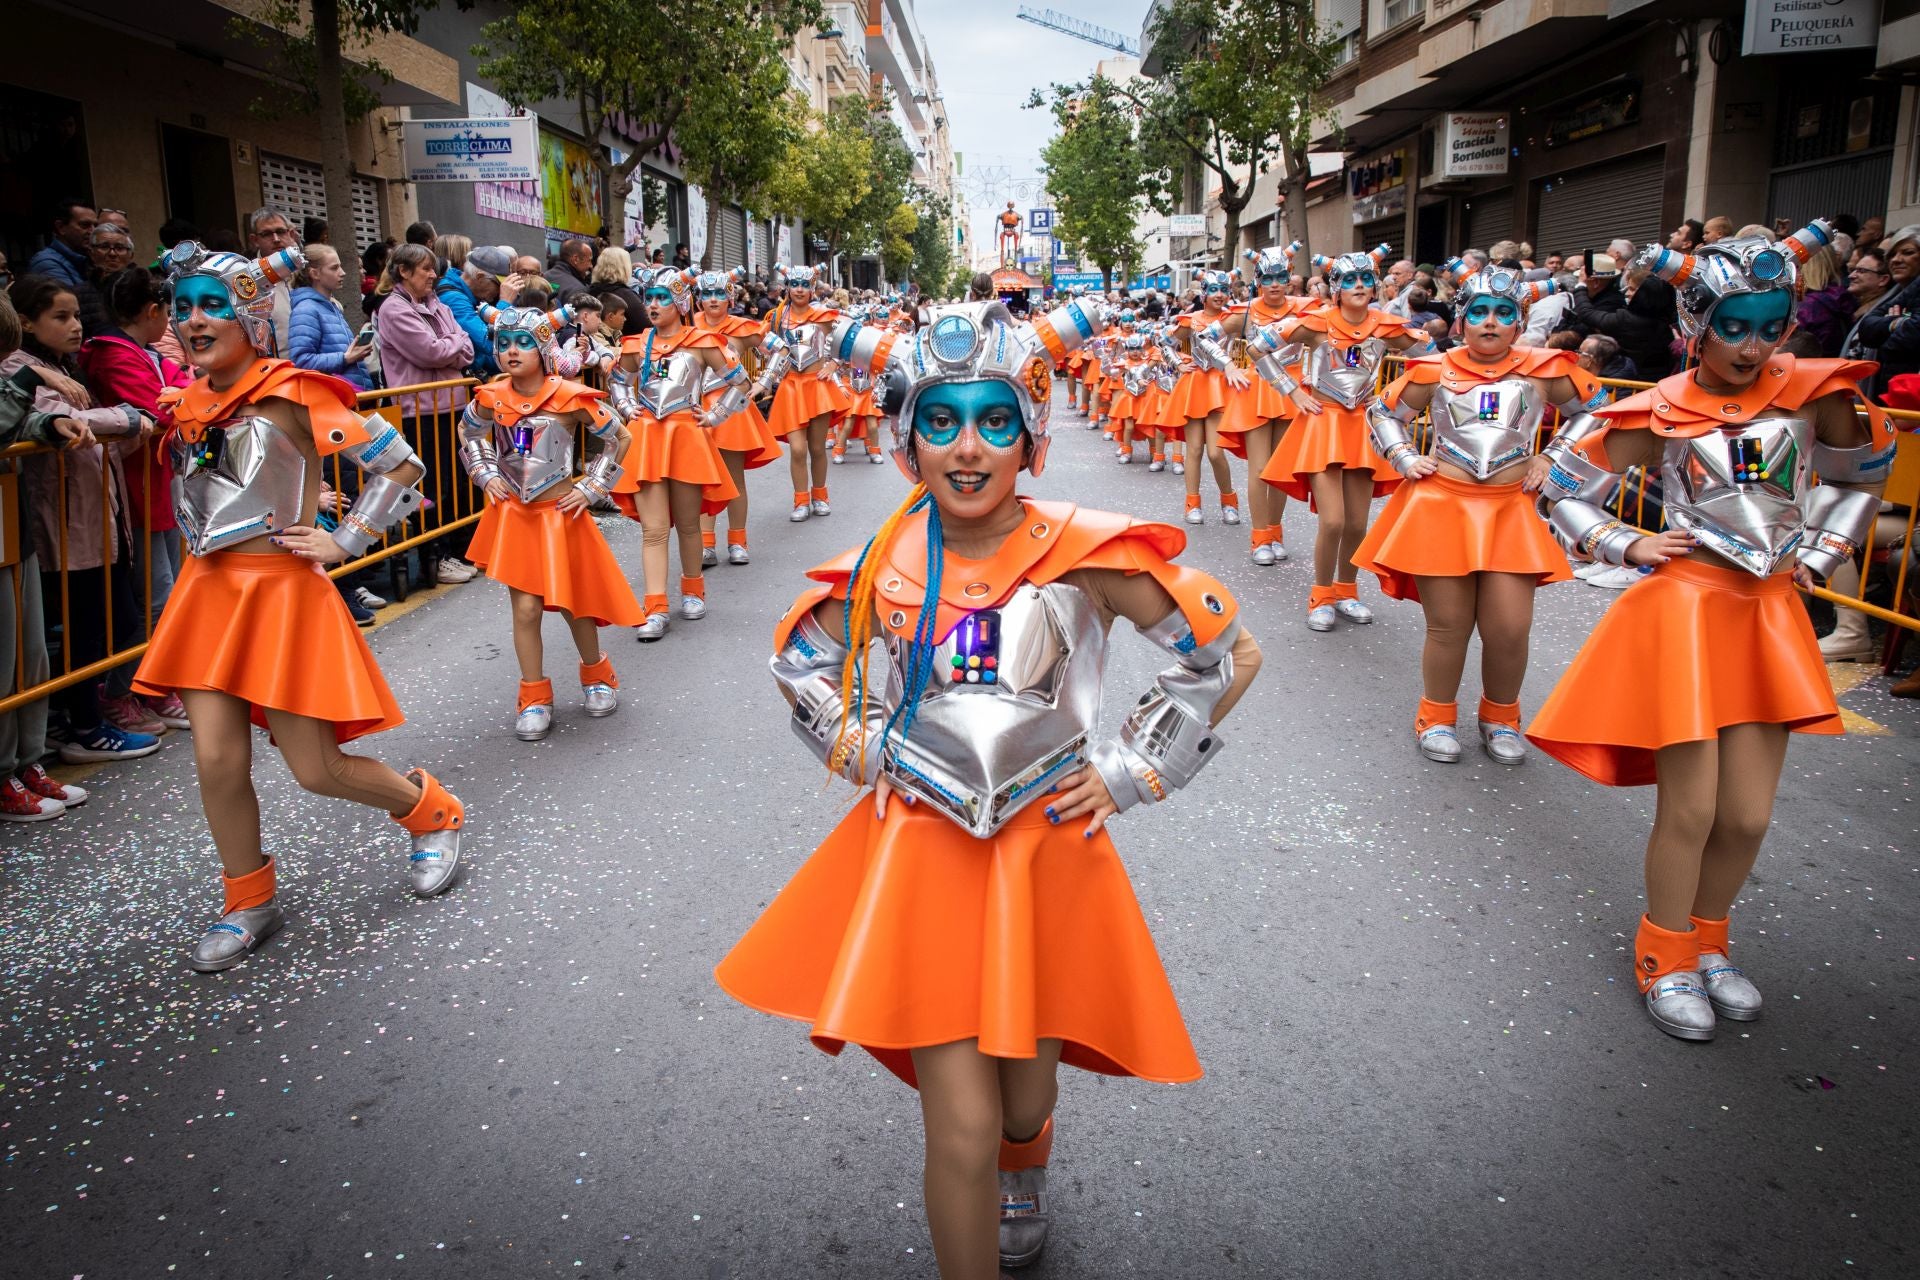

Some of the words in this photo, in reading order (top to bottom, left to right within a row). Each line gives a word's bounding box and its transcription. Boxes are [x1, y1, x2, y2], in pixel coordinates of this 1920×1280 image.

[1774, 0, 1822, 12] Estilistas
[1770, 15, 1854, 32] PELUQUERÍA
[1780, 33, 1842, 48] ESTÉTICA
[424, 121, 511, 129] INSTALACIONES
[427, 140, 511, 153] TORRECLIMA
[1453, 136, 1495, 150] Graciela
[1452, 147, 1506, 163] Bortolotto
[480, 191, 541, 221] HERRAMIENTAS
